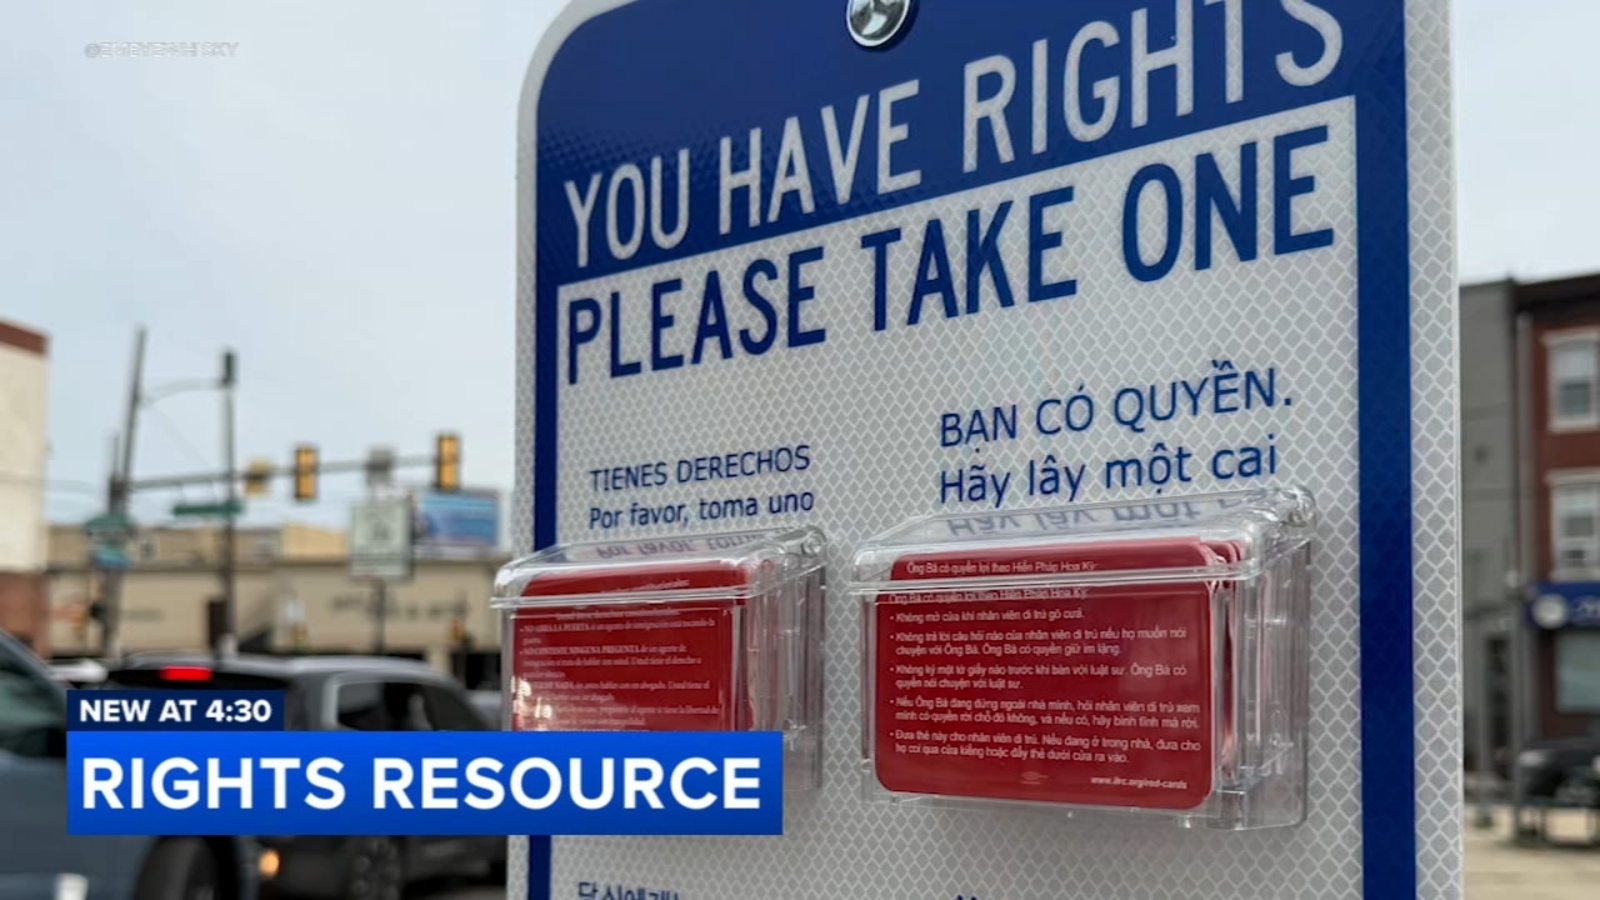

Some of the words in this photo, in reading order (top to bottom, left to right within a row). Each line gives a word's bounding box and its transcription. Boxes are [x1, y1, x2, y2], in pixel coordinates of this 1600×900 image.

[564, 149, 690, 268] YOU
[719, 79, 921, 235] HAVE
[962, 0, 1343, 173] RIGHTS
[569, 246, 826, 385] PLEASE
[861, 186, 1077, 331] TAKE
[1122, 125, 1333, 282] ONE
[940, 404, 1017, 453] BẠN
[1035, 385, 1094, 435] CÓ
[1113, 359, 1292, 433] QUYỀN.
[589, 462, 668, 491] TIENES
[676, 445, 811, 483] DERECHOS
[940, 464, 1011, 508] Hãy
[1028, 455, 1086, 502] lây
[1105, 443, 1192, 494] một
[1211, 433, 1277, 479] cai
[589, 506, 622, 530] Por
[629, 501, 690, 527] favor,
[699, 496, 758, 521] toma
[769, 491, 815, 514] uno
